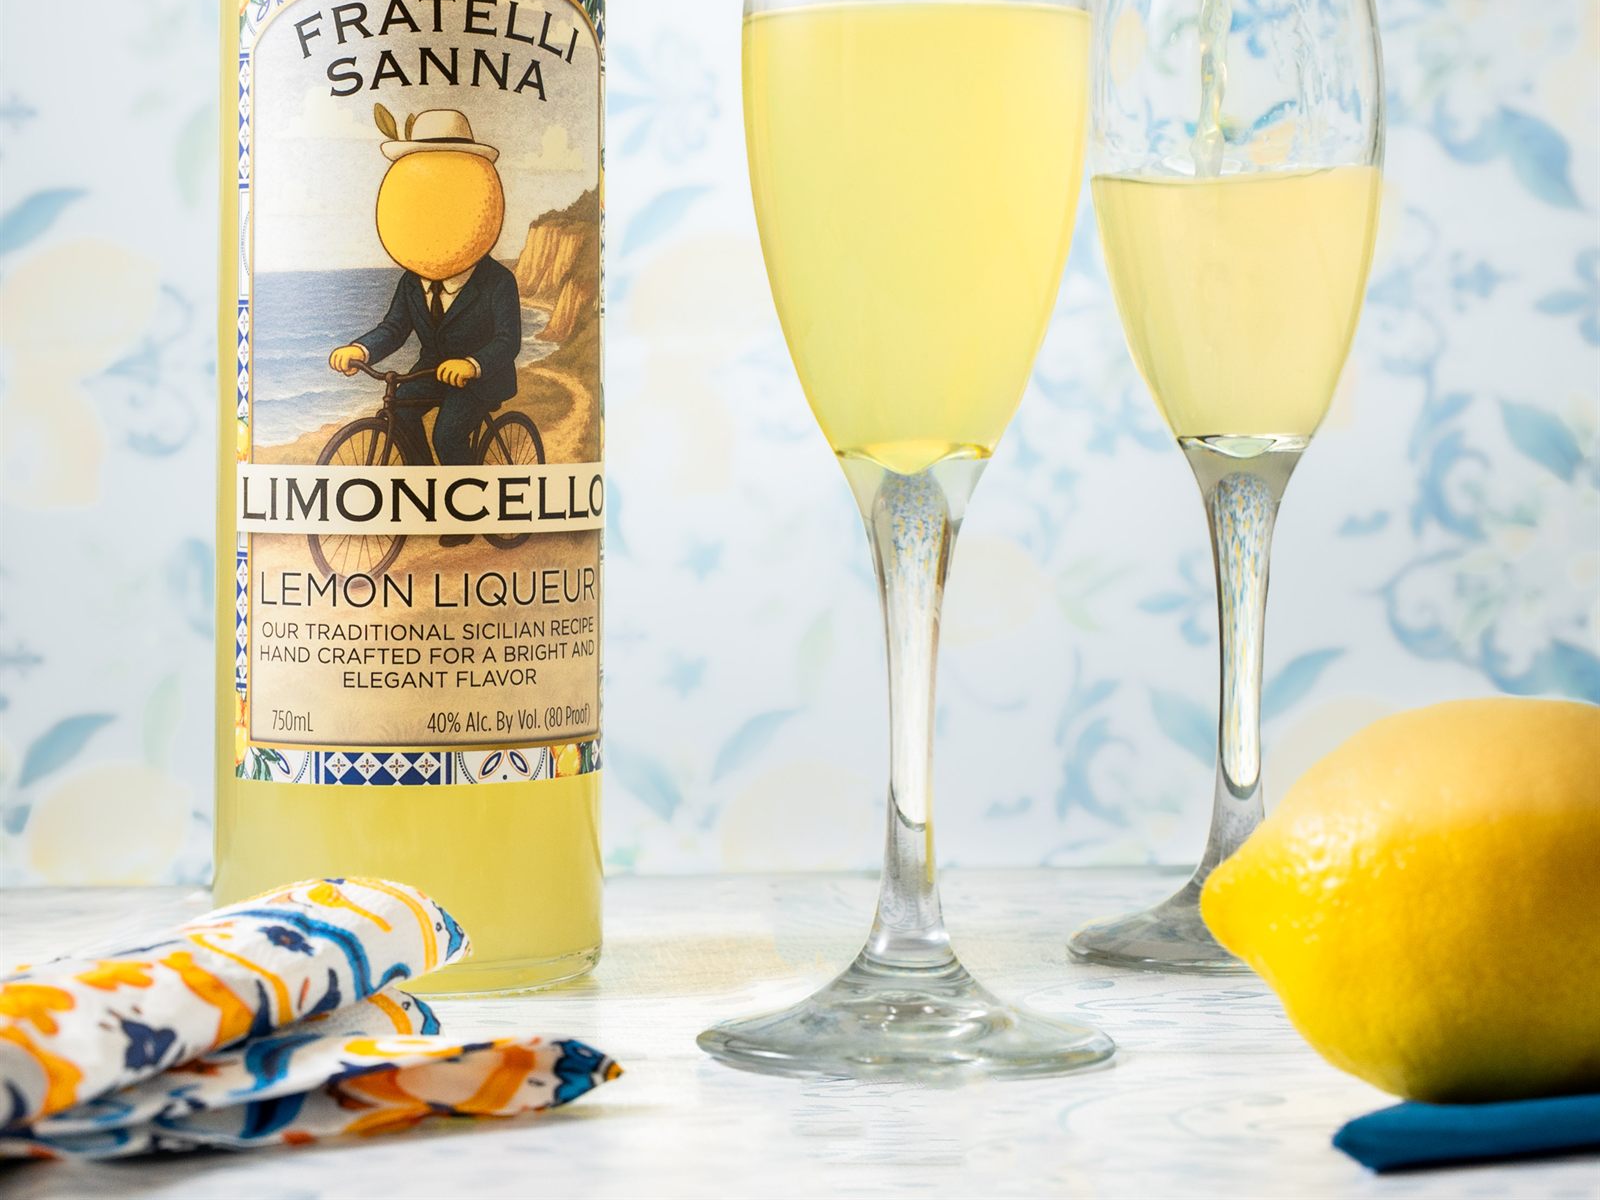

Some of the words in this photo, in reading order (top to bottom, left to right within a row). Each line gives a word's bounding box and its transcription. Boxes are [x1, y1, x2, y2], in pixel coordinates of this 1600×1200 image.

[326, 47, 547, 102] SANNA
[242, 474, 603, 522] LIMONCELLO
[260, 571, 413, 608] LEMON
[434, 568, 595, 608] LIQUEUR
[262, 621, 299, 640] OUR
[305, 622, 455, 641] TRADITIONAL
[462, 620, 545, 641] SICILIAN
[550, 616, 594, 637] RECIPE
[259, 645, 311, 664] HAND
[317, 647, 421, 665] CRAFTED
[429, 646, 474, 664] FOR
[482, 646, 497, 664] A
[504, 642, 566, 663] BRIGHT
[571, 642, 595, 658] AND
[343, 671, 448, 689] ELEGANT
[456, 668, 537, 688] FLAVOR
[271, 709, 314, 732] 750mL
[426, 711, 461, 734] 40%
[465, 710, 492, 733] Alc.
[496, 710, 513, 734] By
[517, 708, 541, 730] Vol.
[544, 706, 562, 732] (80
[565, 704, 591, 726] Proof)
